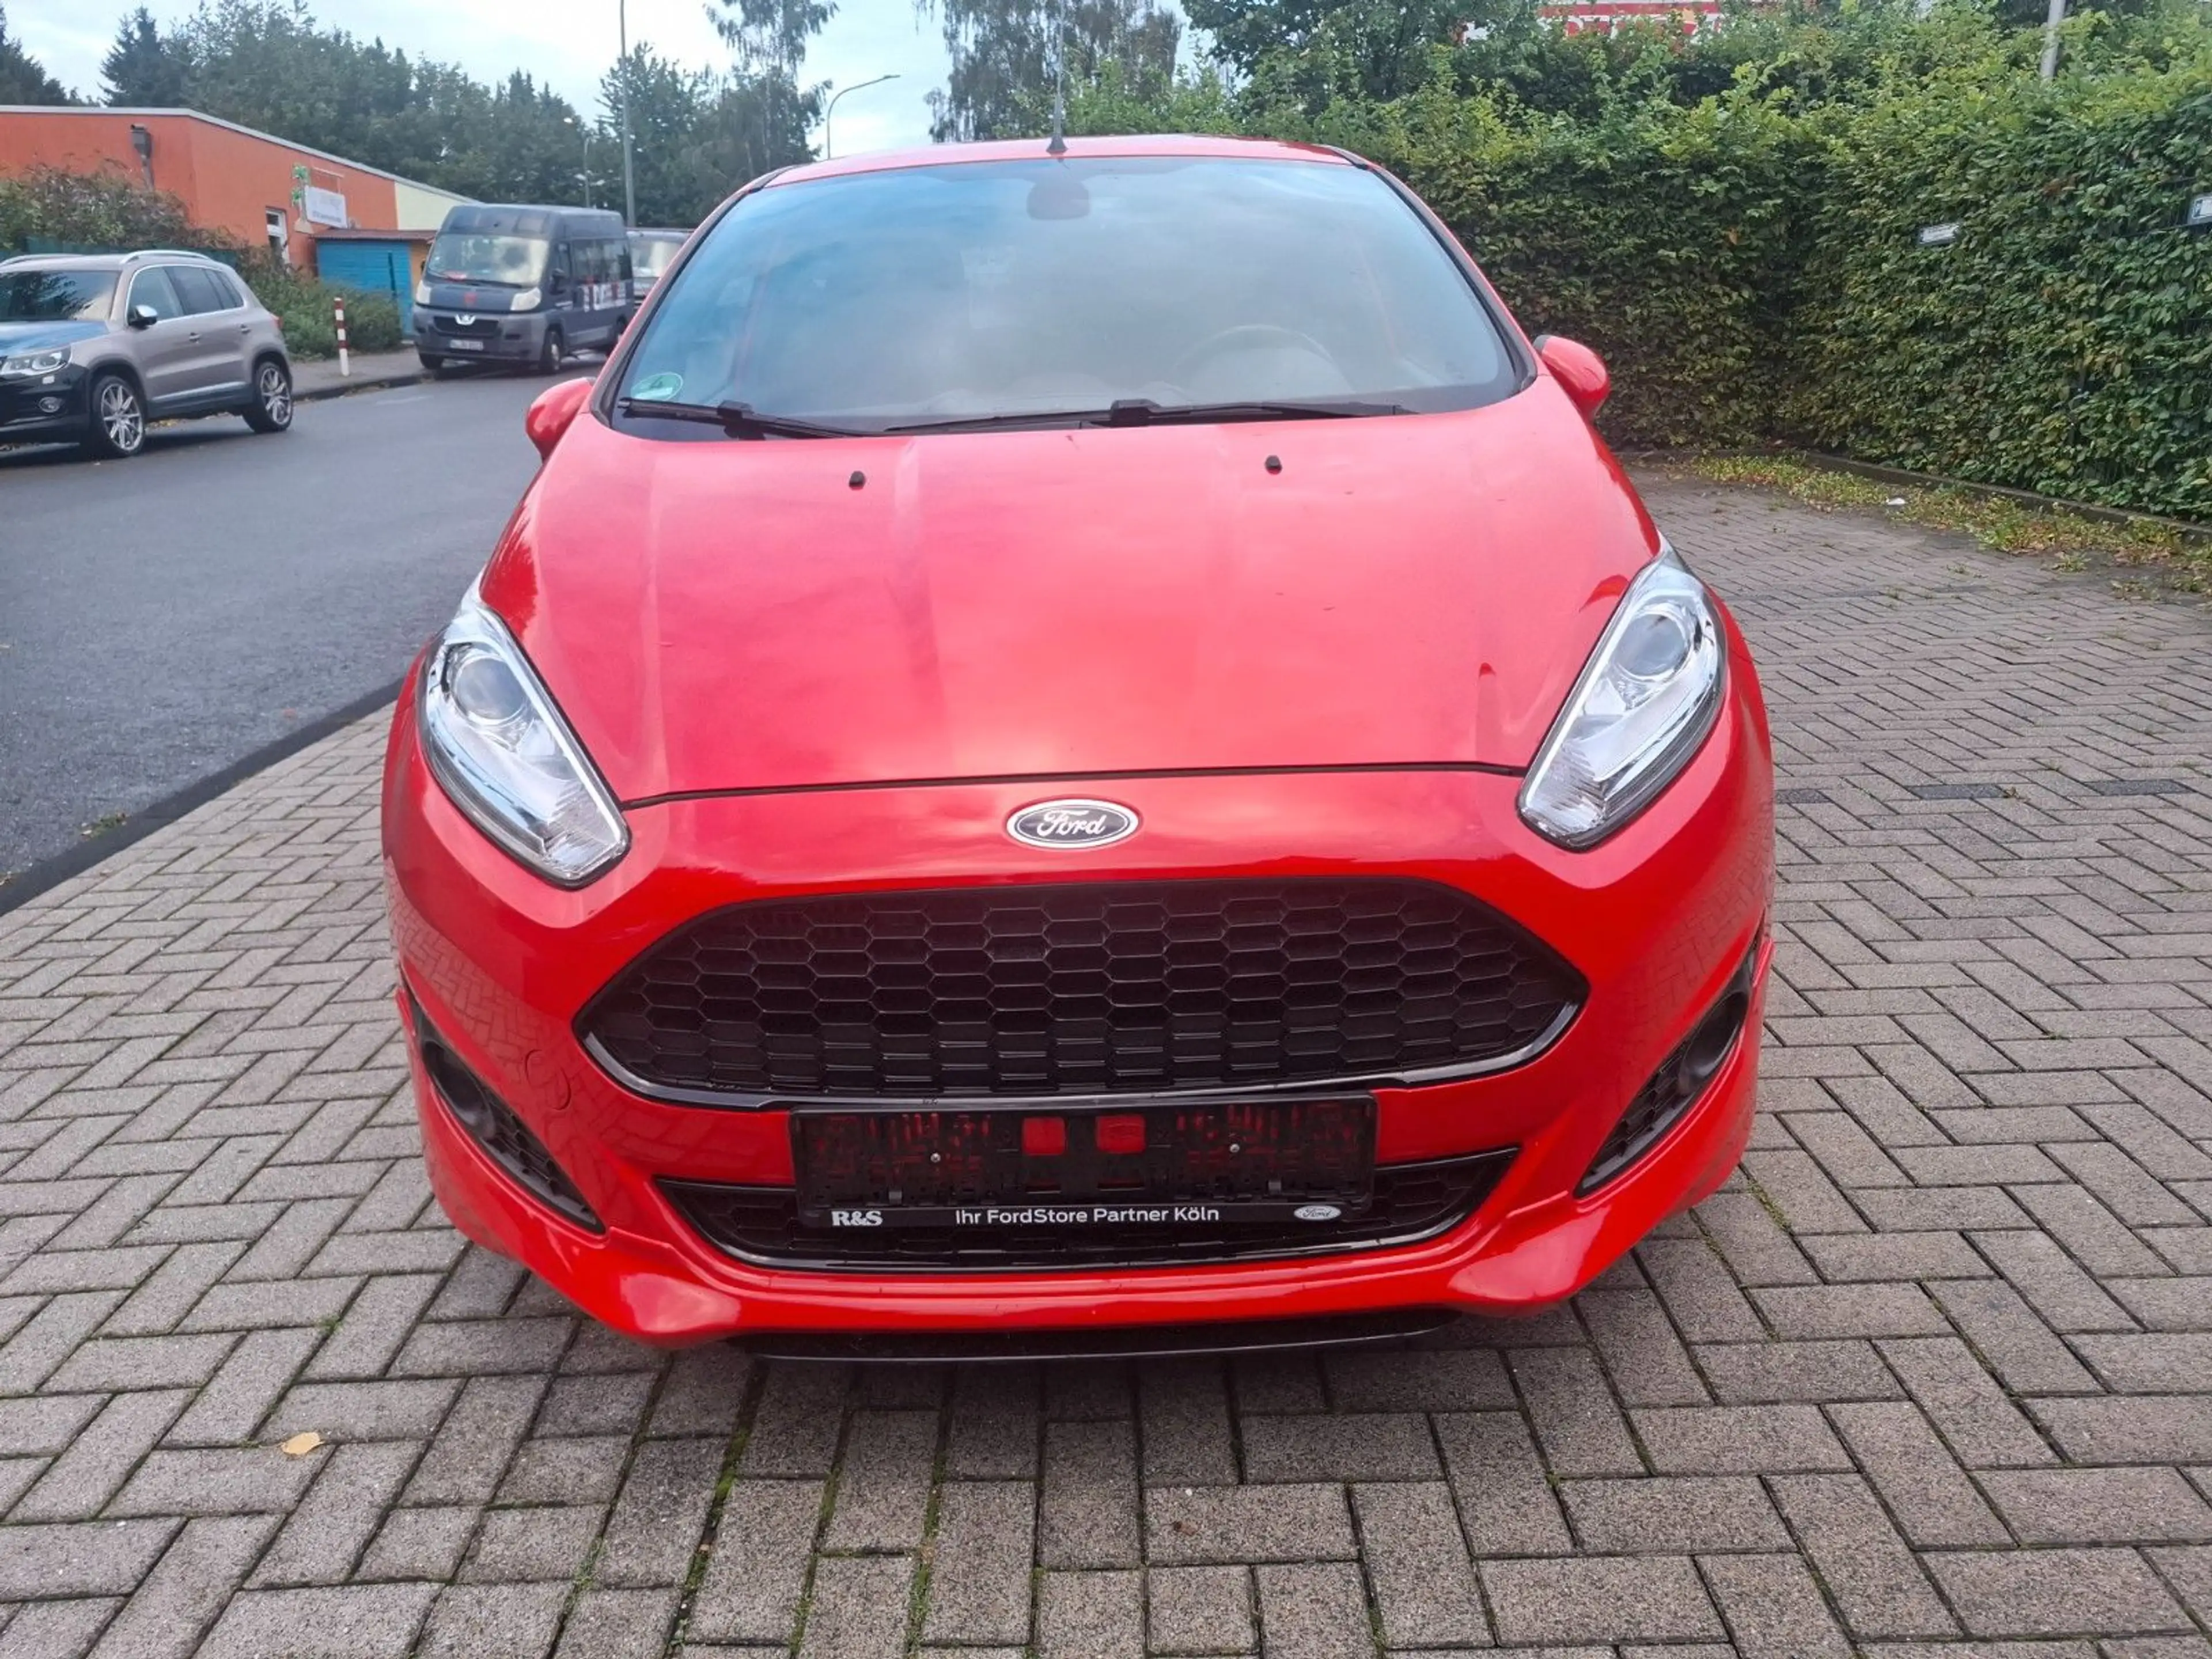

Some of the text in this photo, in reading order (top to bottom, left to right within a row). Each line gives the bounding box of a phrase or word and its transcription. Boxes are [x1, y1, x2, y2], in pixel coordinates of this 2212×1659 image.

[1036, 809, 1107, 837] Ford
[831, 1210, 883, 1226] R&S
[955, 1207, 1219, 1224] Ihr FordStore Partner Köln
